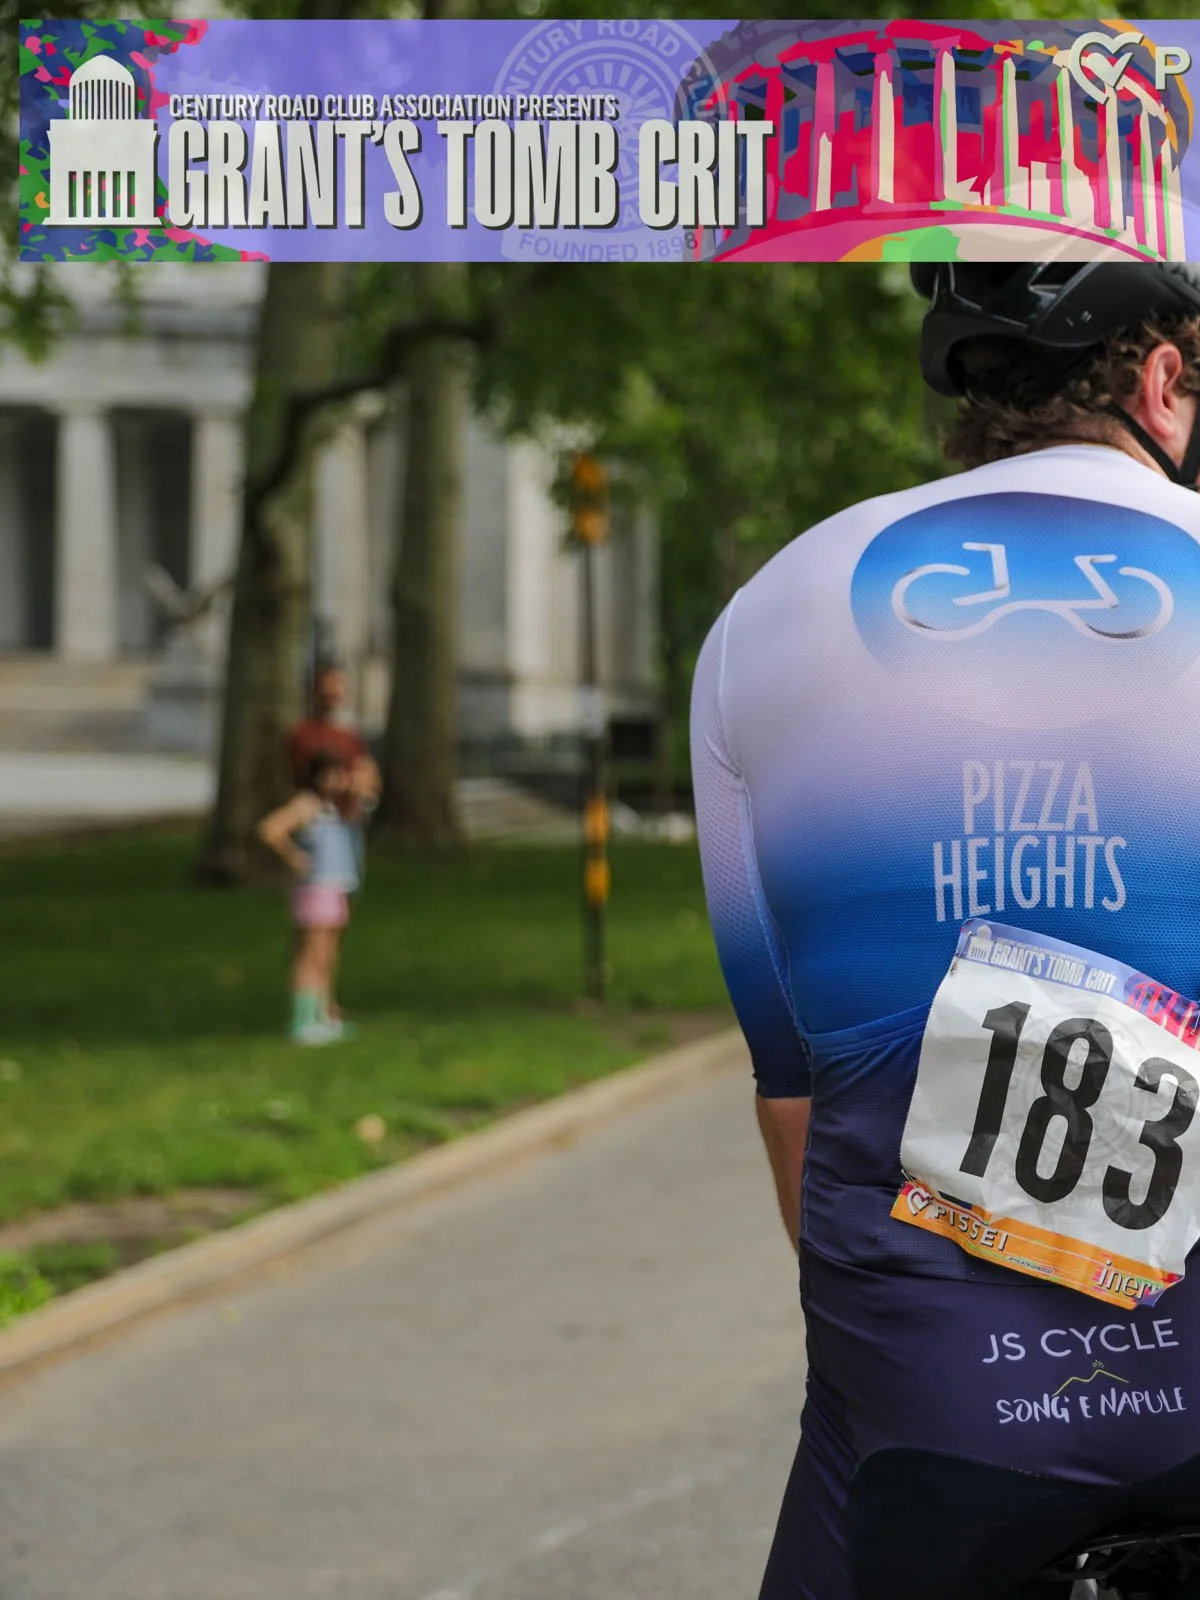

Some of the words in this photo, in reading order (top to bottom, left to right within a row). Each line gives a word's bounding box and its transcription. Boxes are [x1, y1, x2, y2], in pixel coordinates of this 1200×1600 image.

[962, 760, 1099, 835] PIZZA
[932, 834, 1128, 922] HEIGHTS
[990, 942, 1046, 977] GRANT'S
[1045, 954, 1087, 987] TOMB
[1084, 967, 1118, 994] CRIT
[958, 1000, 1200, 1231] 183
[933, 1204, 1010, 1252] PISSEI
[982, 1332, 1027, 1364] JS
[1040, 1318, 1180, 1358] CYCLE
[1079, 1395, 1094, 1419] E
[1100, 1386, 1188, 1417] NAPULE
